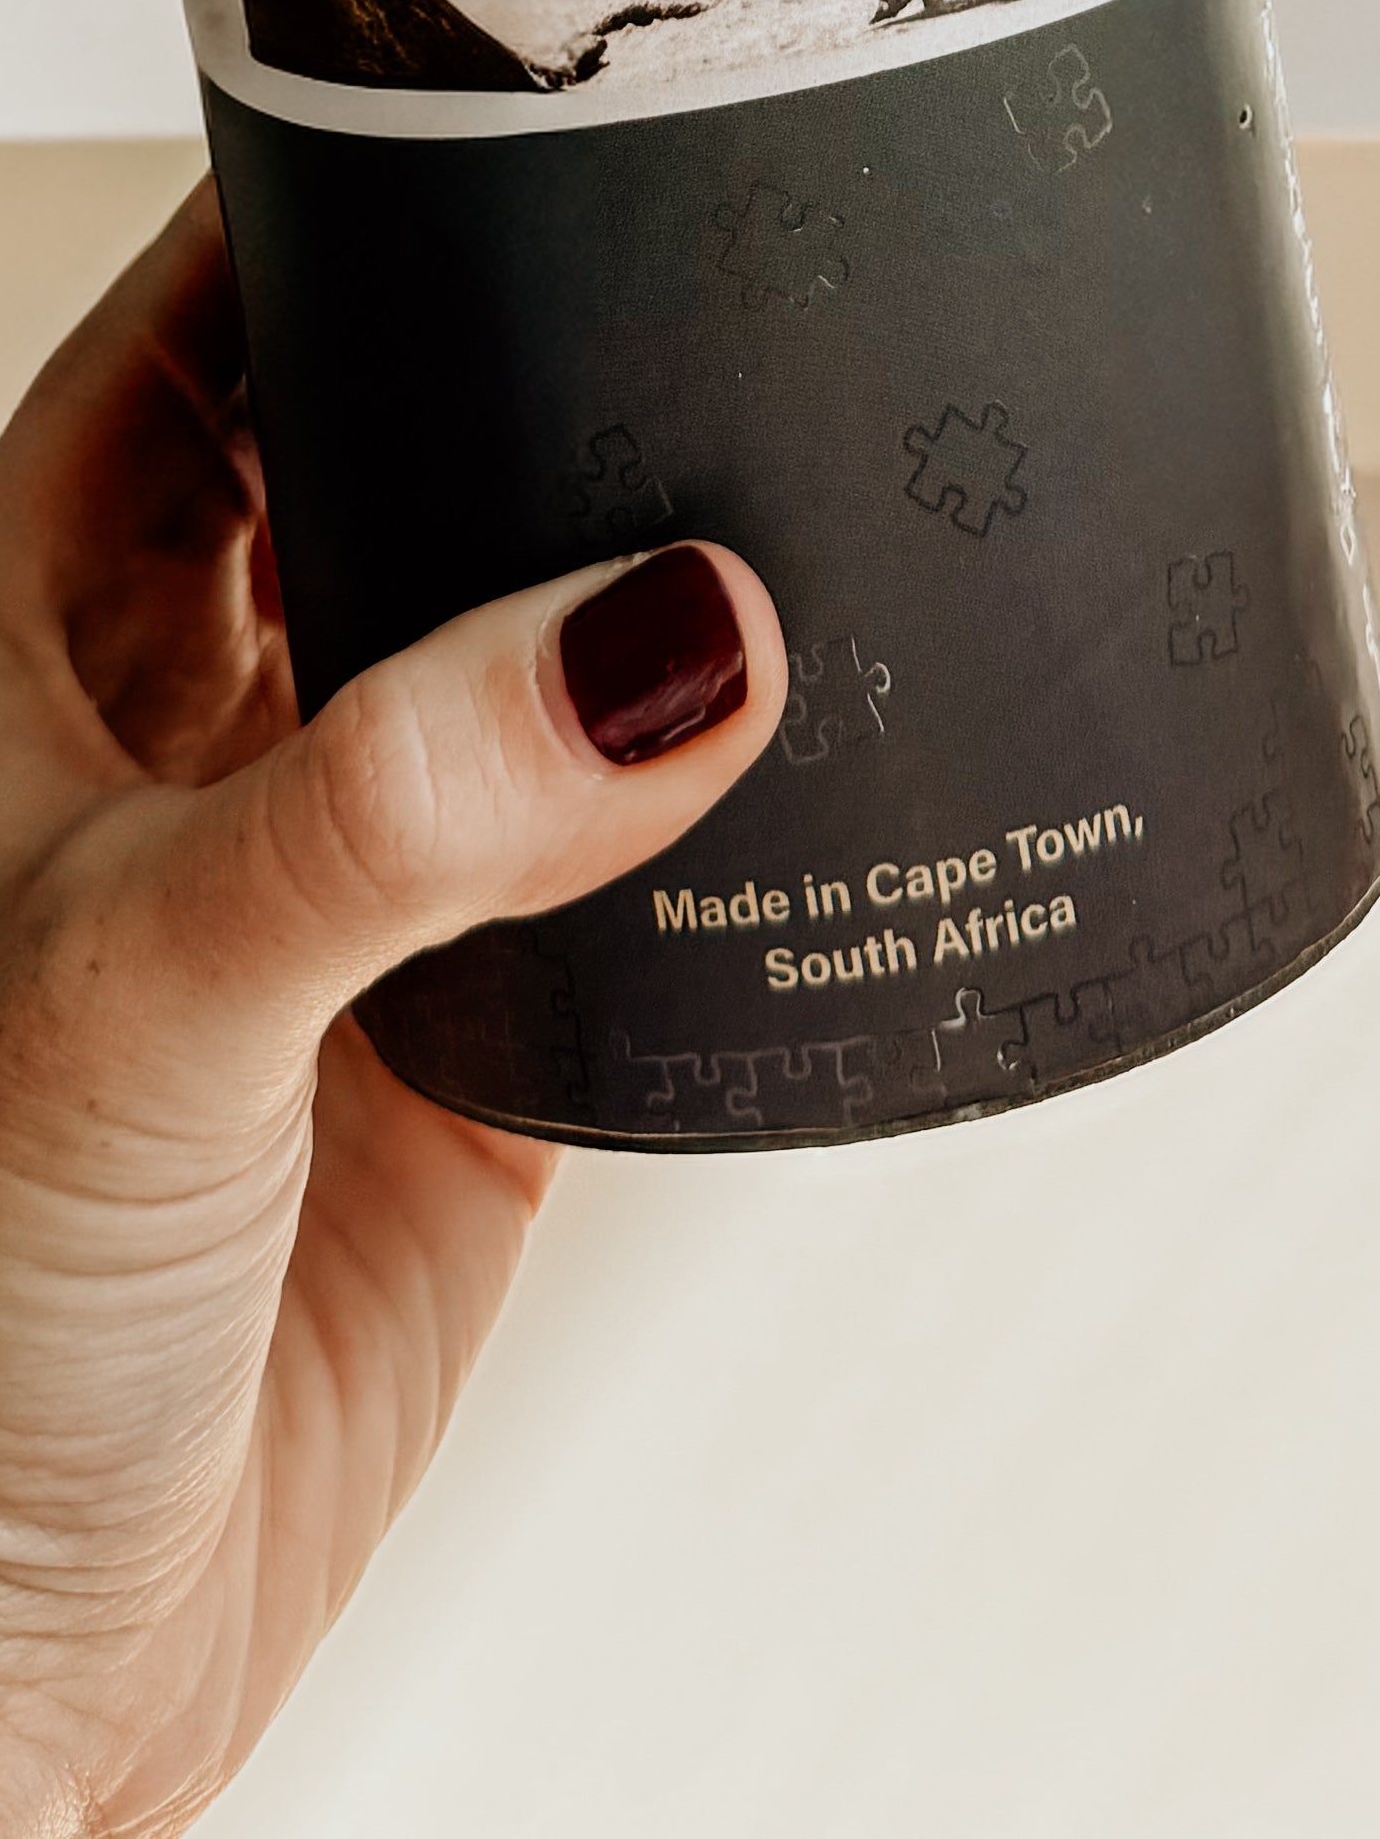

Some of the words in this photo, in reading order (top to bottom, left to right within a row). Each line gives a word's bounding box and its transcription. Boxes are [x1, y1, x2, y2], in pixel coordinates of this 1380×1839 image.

[651, 880, 791, 933] Made
[803, 874, 852, 920] in
[865, 848, 998, 905] Cape
[1005, 801, 1145, 873] Town,
[764, 928, 919, 992] South
[932, 892, 1078, 965] Africa
